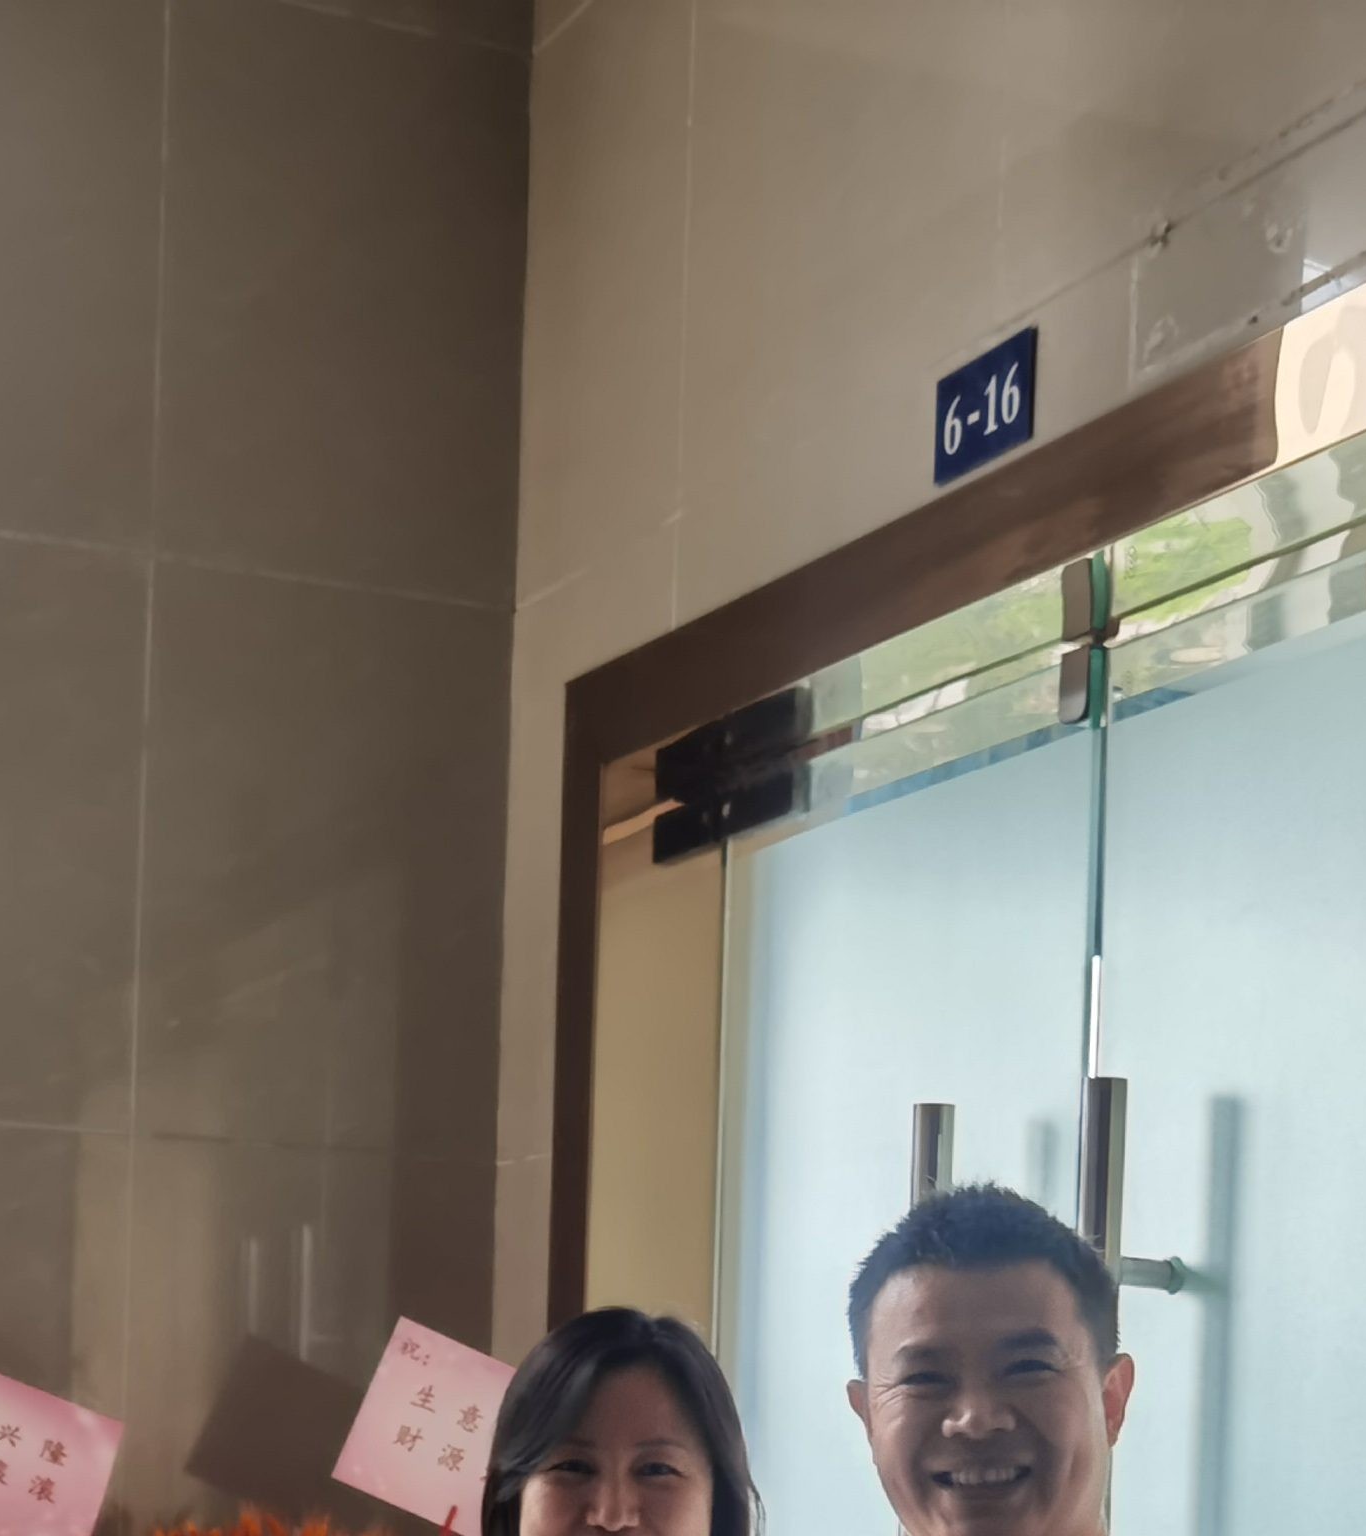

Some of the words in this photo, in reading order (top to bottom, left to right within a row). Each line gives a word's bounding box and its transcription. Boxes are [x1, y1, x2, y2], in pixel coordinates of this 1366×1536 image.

[943, 361, 1021, 456] 6-16
[409, 1384, 484, 1434] 生意
[393, 1424, 488, 1482] 财源
